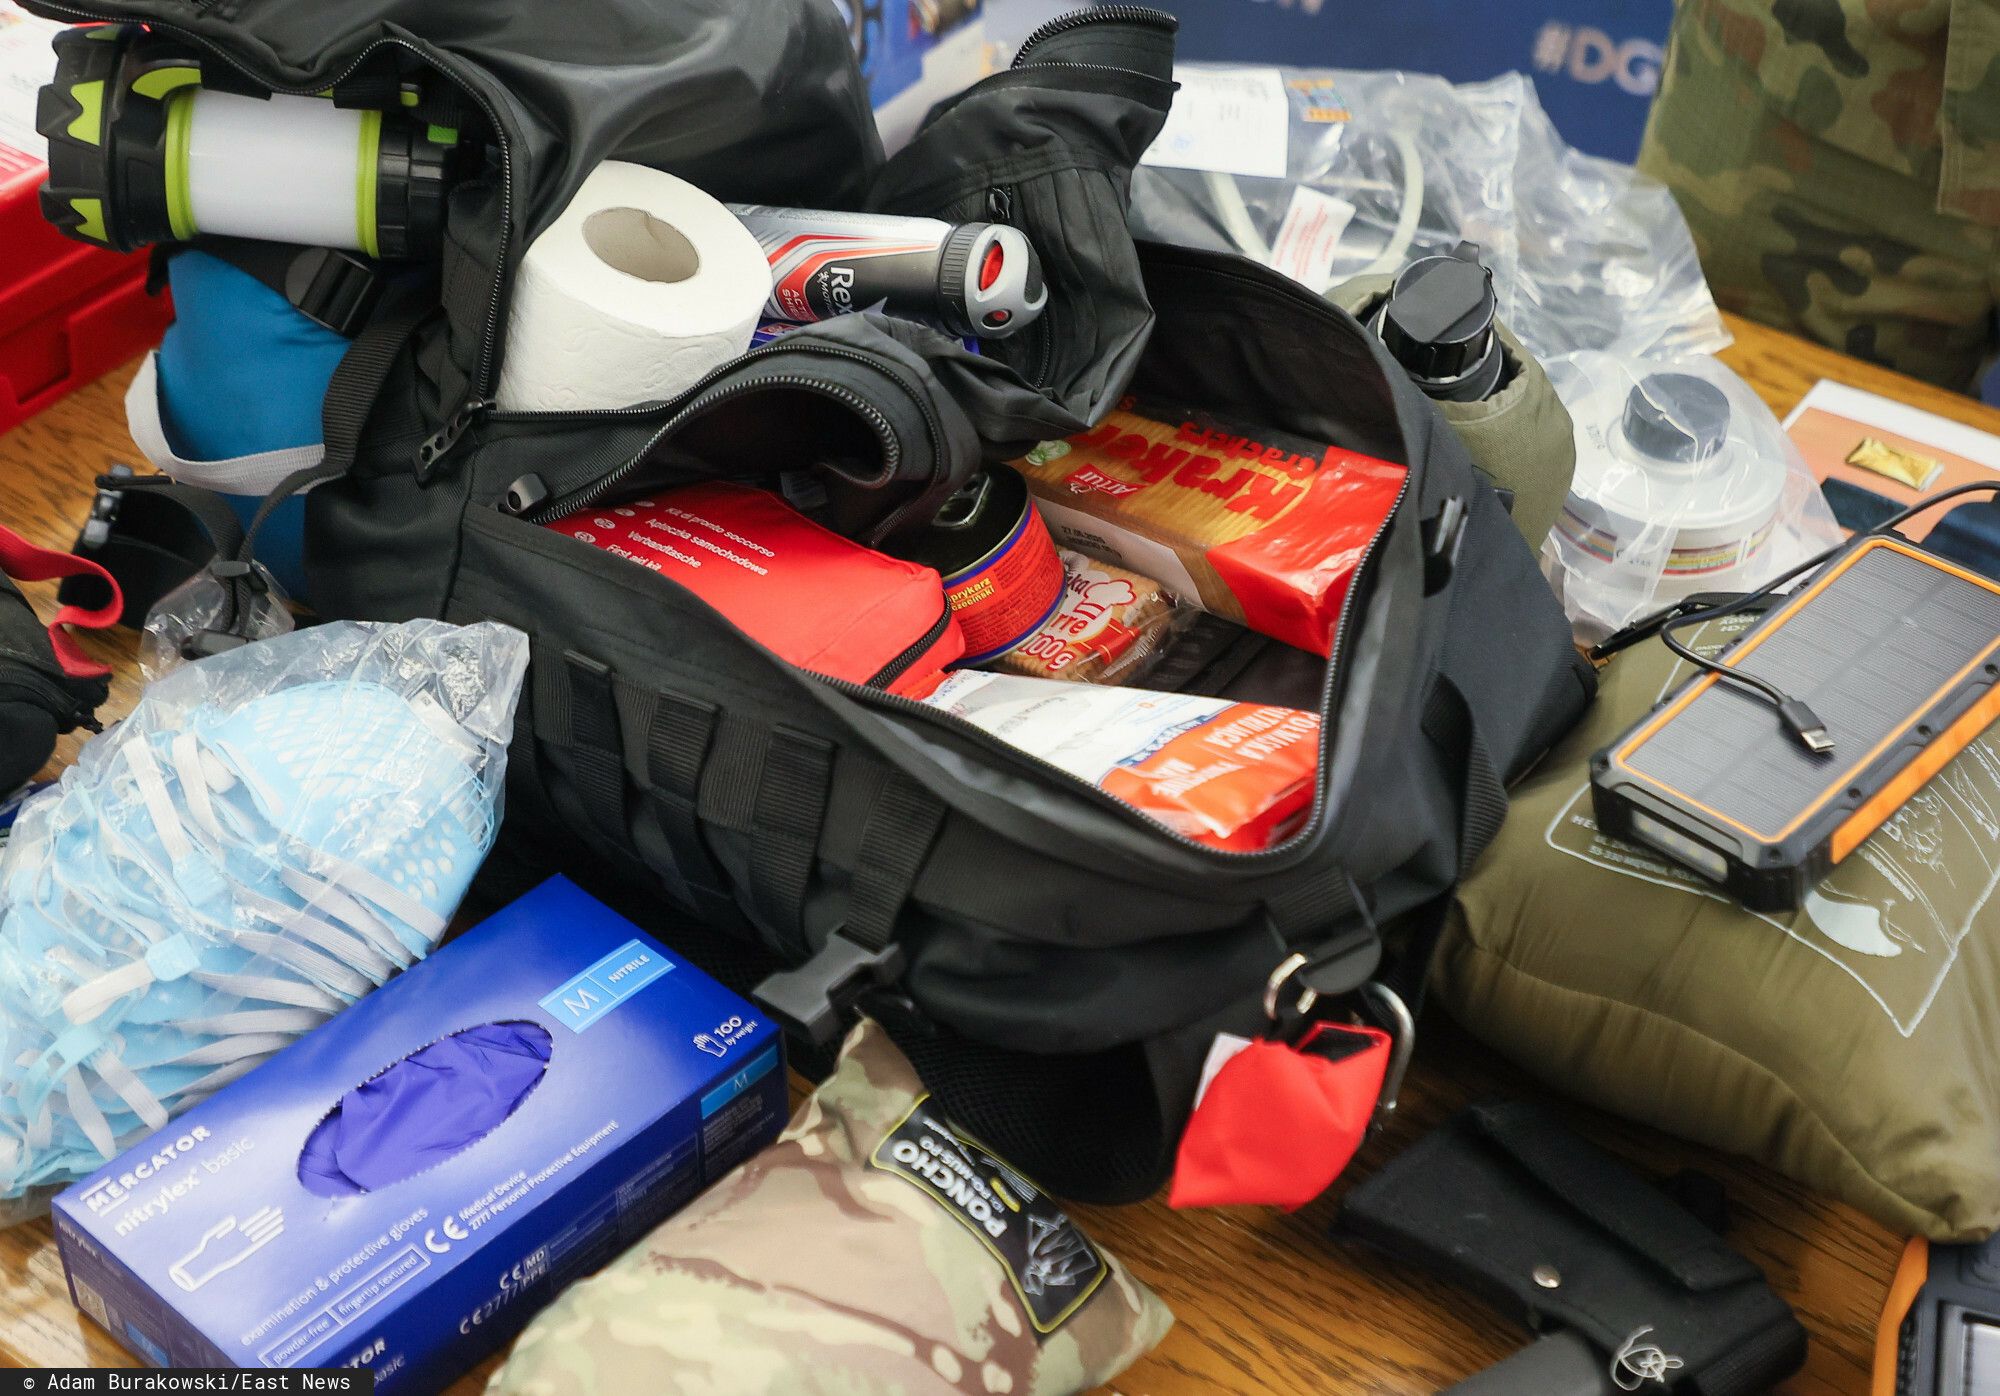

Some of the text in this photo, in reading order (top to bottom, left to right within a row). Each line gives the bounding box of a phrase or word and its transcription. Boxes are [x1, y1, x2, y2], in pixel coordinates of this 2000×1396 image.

[606, 544, 632, 559] First
[627, 530, 701, 569] Verbandtasche
[645, 518, 768, 576] Apteczka samochodowa
[690, 516, 725, 534] pronto
[724, 531, 775, 558] soccorso
[950, 577, 992, 602] prykarz
[1050, 613, 1088, 635] rre
[608, 952, 651, 985] NITRILE
[563, 987, 601, 1017] M
[713, 1014, 742, 1037] 100
[734, 1019, 758, 1042] weight
[85, 1125, 213, 1216] MERCATOR
[204, 1136, 256, 1177] basic
[489, 1185, 529, 1219] Personal
[527, 1155, 571, 1192] Protective
[569, 1120, 620, 1163] Equipment
[460, 1170, 528, 1221] Medical Device
[892, 1139, 1008, 1239] PONCHO
[240, 1287, 317, 1347] examination
[328, 1234, 391, 1288] protective
[388, 1207, 430, 1242] gloves
[376, 1254, 419, 1294] textured
[526, 1251, 545, 1270] MD
